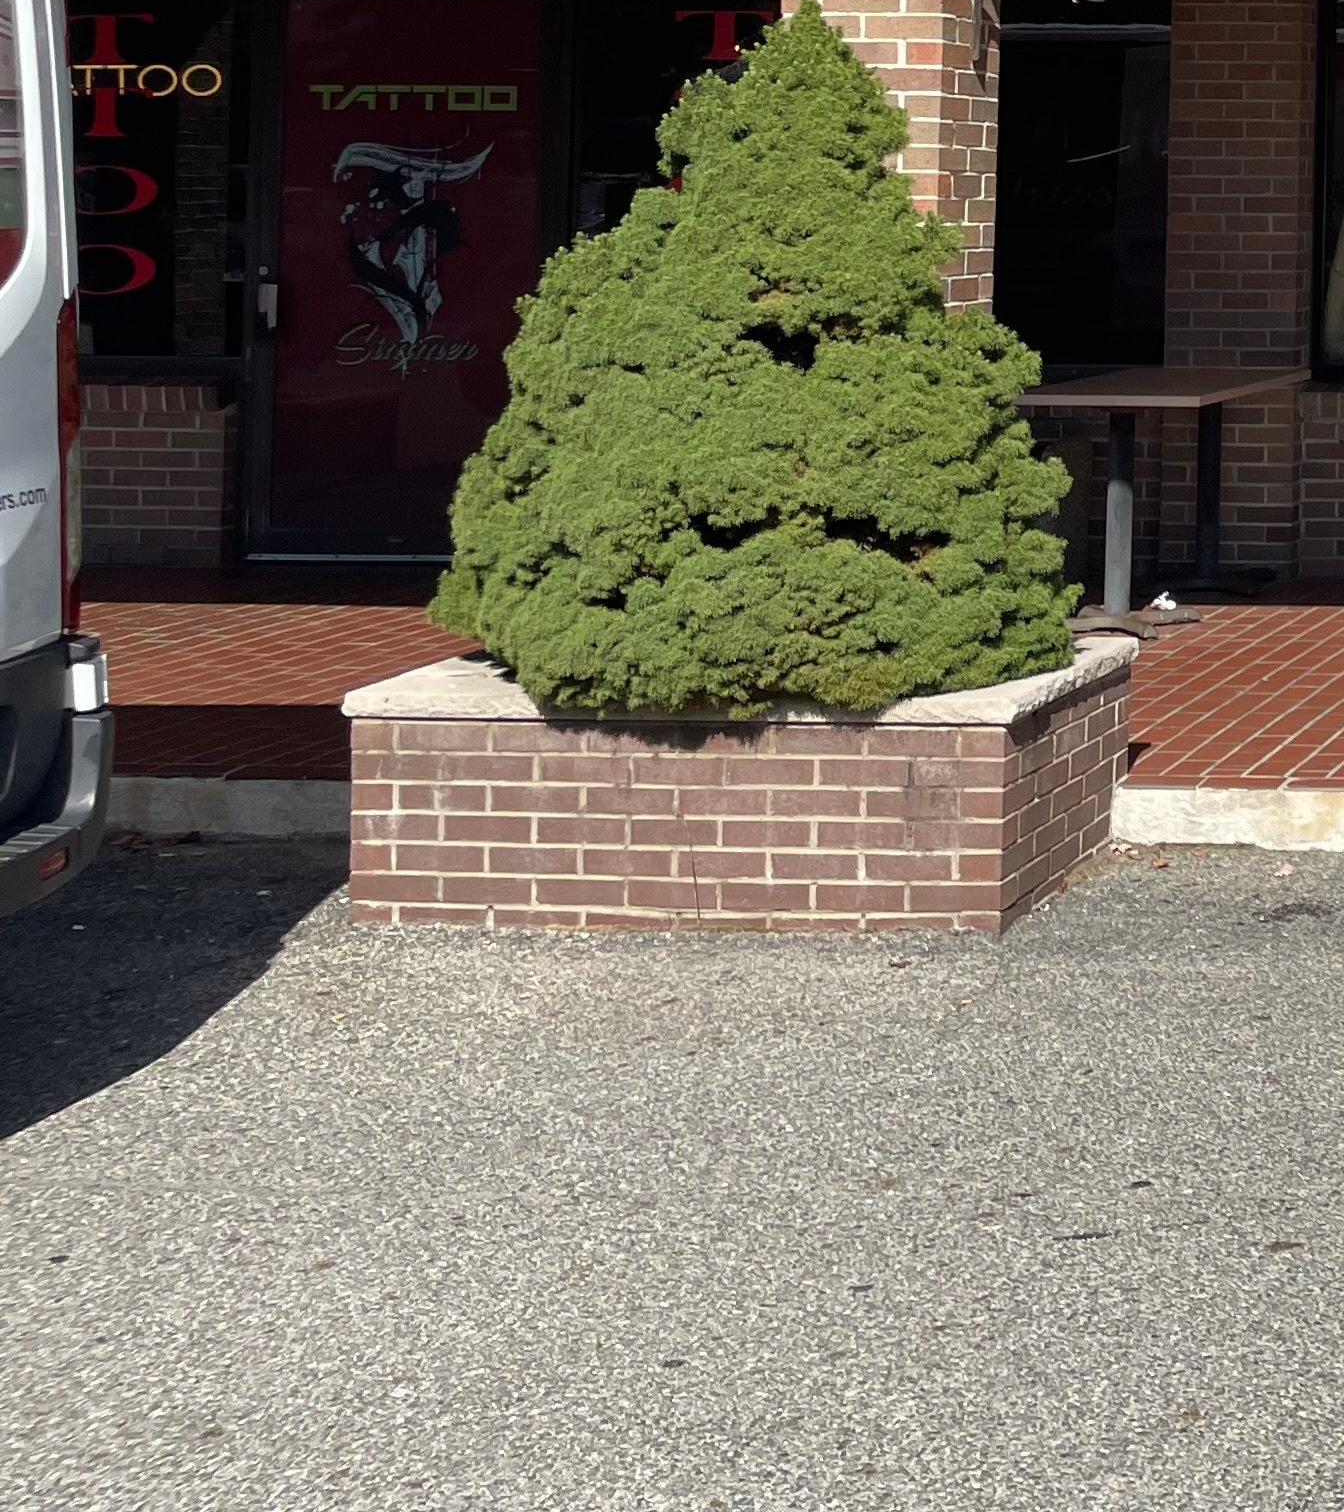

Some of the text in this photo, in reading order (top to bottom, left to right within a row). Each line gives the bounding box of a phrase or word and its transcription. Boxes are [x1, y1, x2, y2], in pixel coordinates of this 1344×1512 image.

[69, 63, 223, 97] TTOO
[308, 83, 519, 113] TATTOO
[0, 488, 47, 512] rs.com
